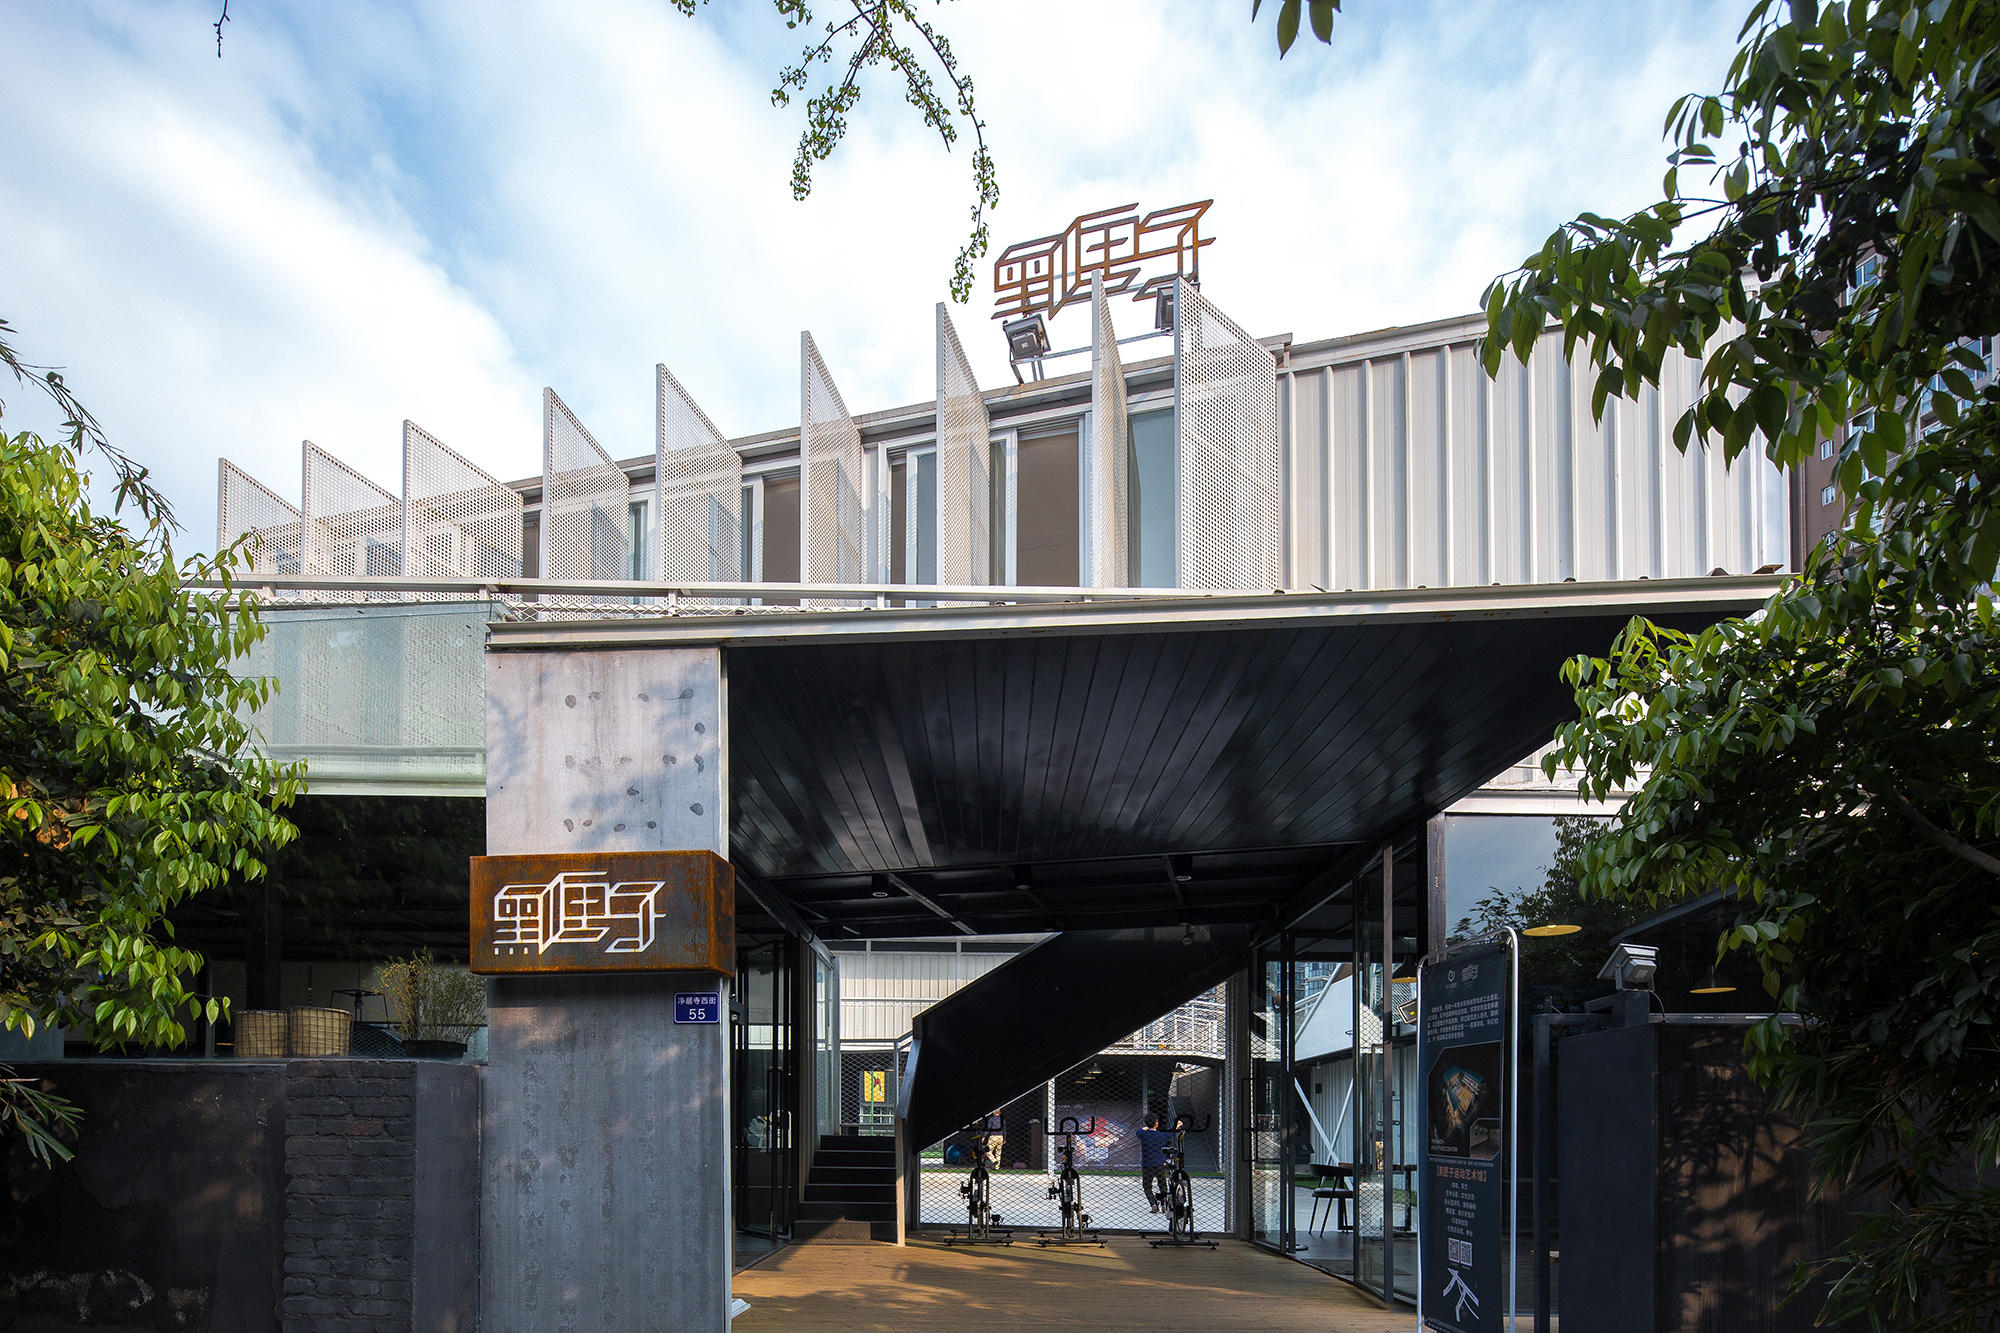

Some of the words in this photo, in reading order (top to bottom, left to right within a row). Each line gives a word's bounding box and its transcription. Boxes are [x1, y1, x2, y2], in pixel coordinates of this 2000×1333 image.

[677, 996, 716, 1006] 净居寺西街
[688, 1008, 706, 1020] 55
